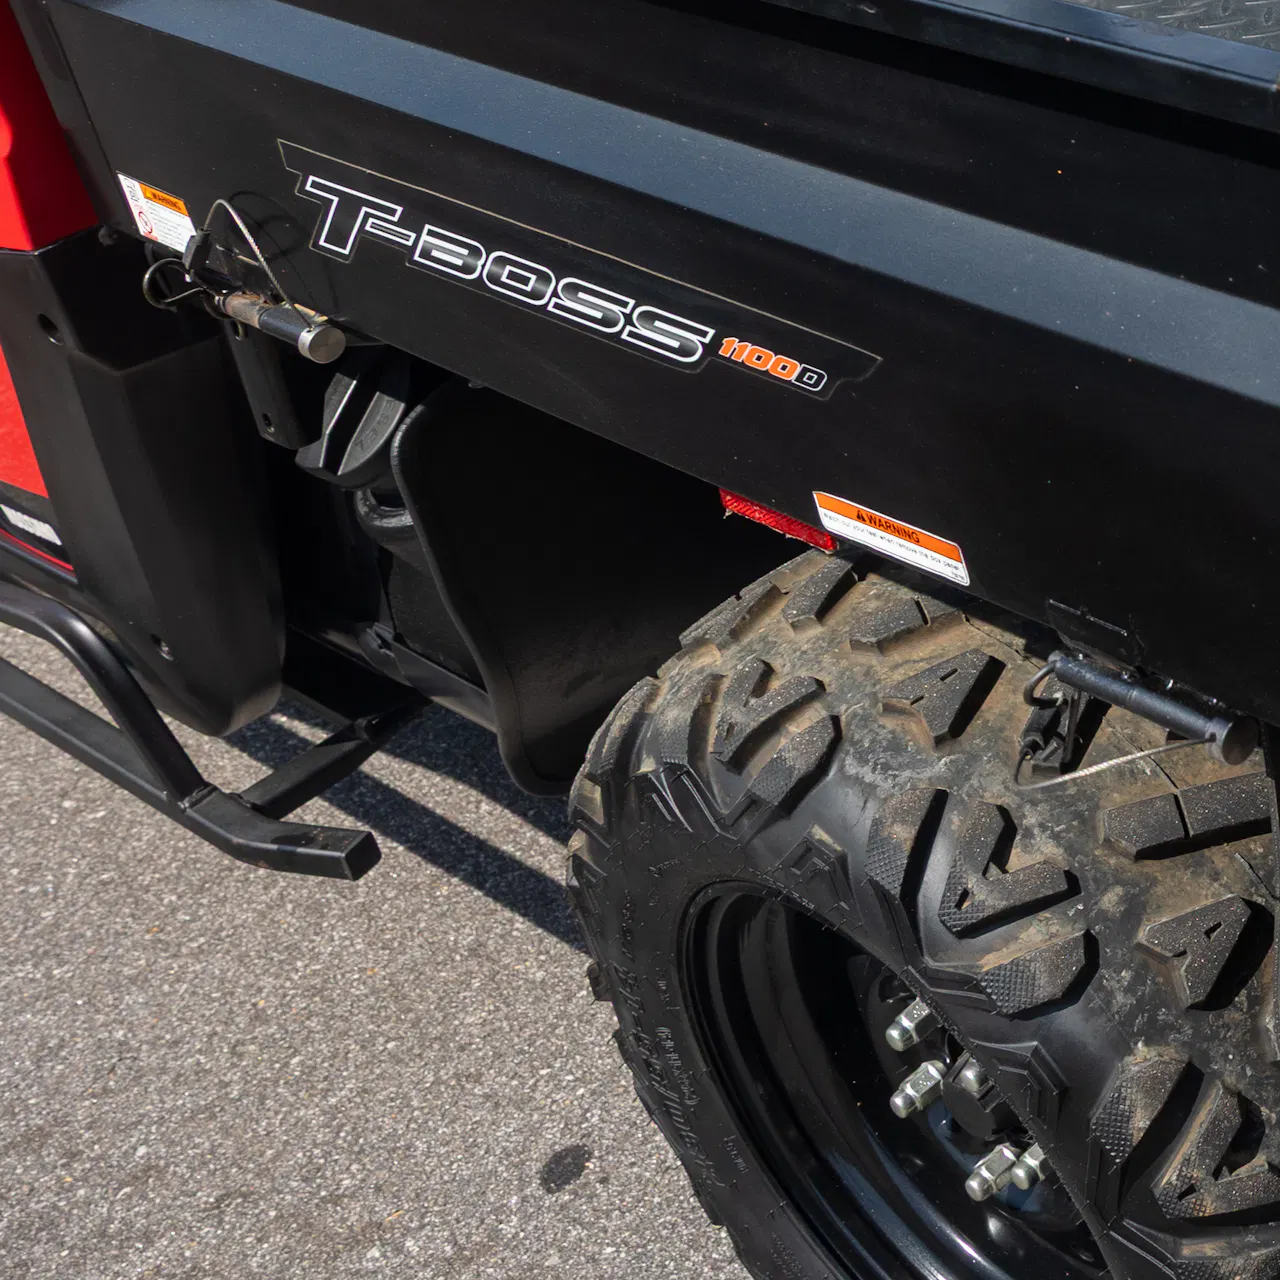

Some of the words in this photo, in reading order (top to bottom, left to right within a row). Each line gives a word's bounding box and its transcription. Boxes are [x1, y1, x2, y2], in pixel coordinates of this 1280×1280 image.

[304, 175, 716, 363] T-BOSS
[717, 336, 828, 393] 1100D
[866, 513, 920, 543] WARNING
